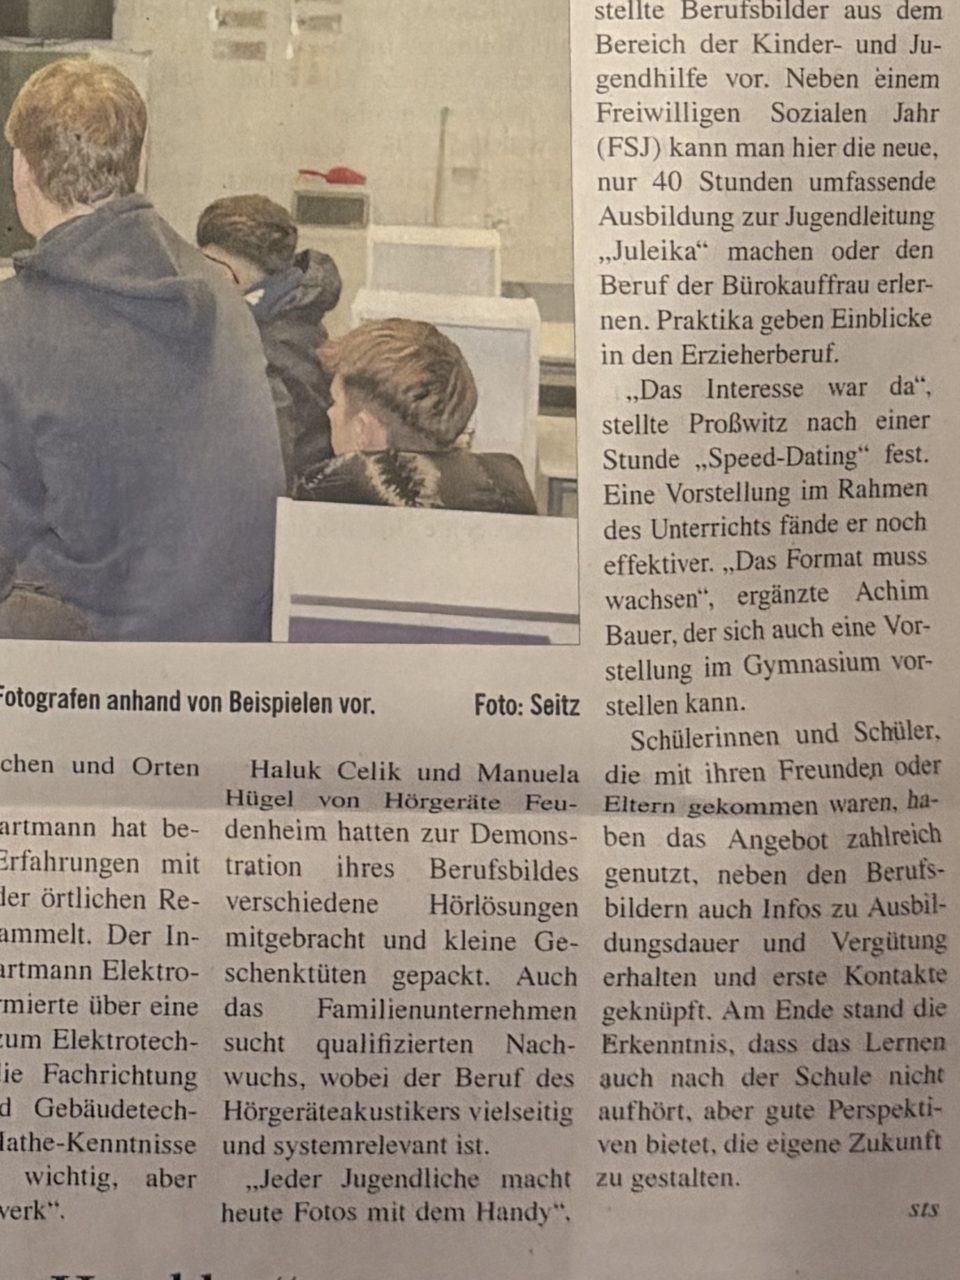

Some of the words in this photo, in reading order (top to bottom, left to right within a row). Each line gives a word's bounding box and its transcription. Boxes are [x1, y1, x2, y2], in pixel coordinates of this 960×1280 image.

[597, 176, 638, 192] nur
[651, 170, 683, 192] 40
[699, 170, 793, 193] Stunden
[809, 169, 937, 193] umfassende
[602, 447, 680, 471] Stunde
[695, 443, 870, 475] „Speed-Dating“
[884, 442, 929, 465] fest.
[604, 587, 714, 611] wachsen“,
[737, 584, 830, 612] ergänzte
[855, 578, 929, 603] Achim
[106, 688, 182, 713] anhand
[186, 694, 223, 713] von
[229, 689, 333, 719] Beispielen
[338, 696, 376, 715] vor.
[474, 692, 524, 717] Foto:
[529, 692, 581, 717] Seitz
[111, 815, 148, 838] hat
[162, 816, 200, 839] be-
[225, 889, 379, 915] verschiedene
[429, 893, 579, 924] Hörlösungen
[603, 930, 740, 960] dungsdauer
[763, 931, 806, 954] und
[831, 930, 948, 959] Vergütung
[52, 1027, 199, 1052] Elektrotech-
[223, 1030, 285, 1054] sucht
[316, 1031, 474, 1061] qualifizierten
[505, 1032, 576, 1056] Nach-
[601, 1032, 735, 1056] Erkenntnis,
[747, 1032, 799, 1054] dass
[811, 1032, 851, 1054] das
[864, 1031, 947, 1053] Lernen
[245, 1167, 324, 1193] „Jeder
[340, 1166, 480, 1196] Jugendliche
[501, 1167, 572, 1190] macht
[908, 1202, 940, 1218] sts
